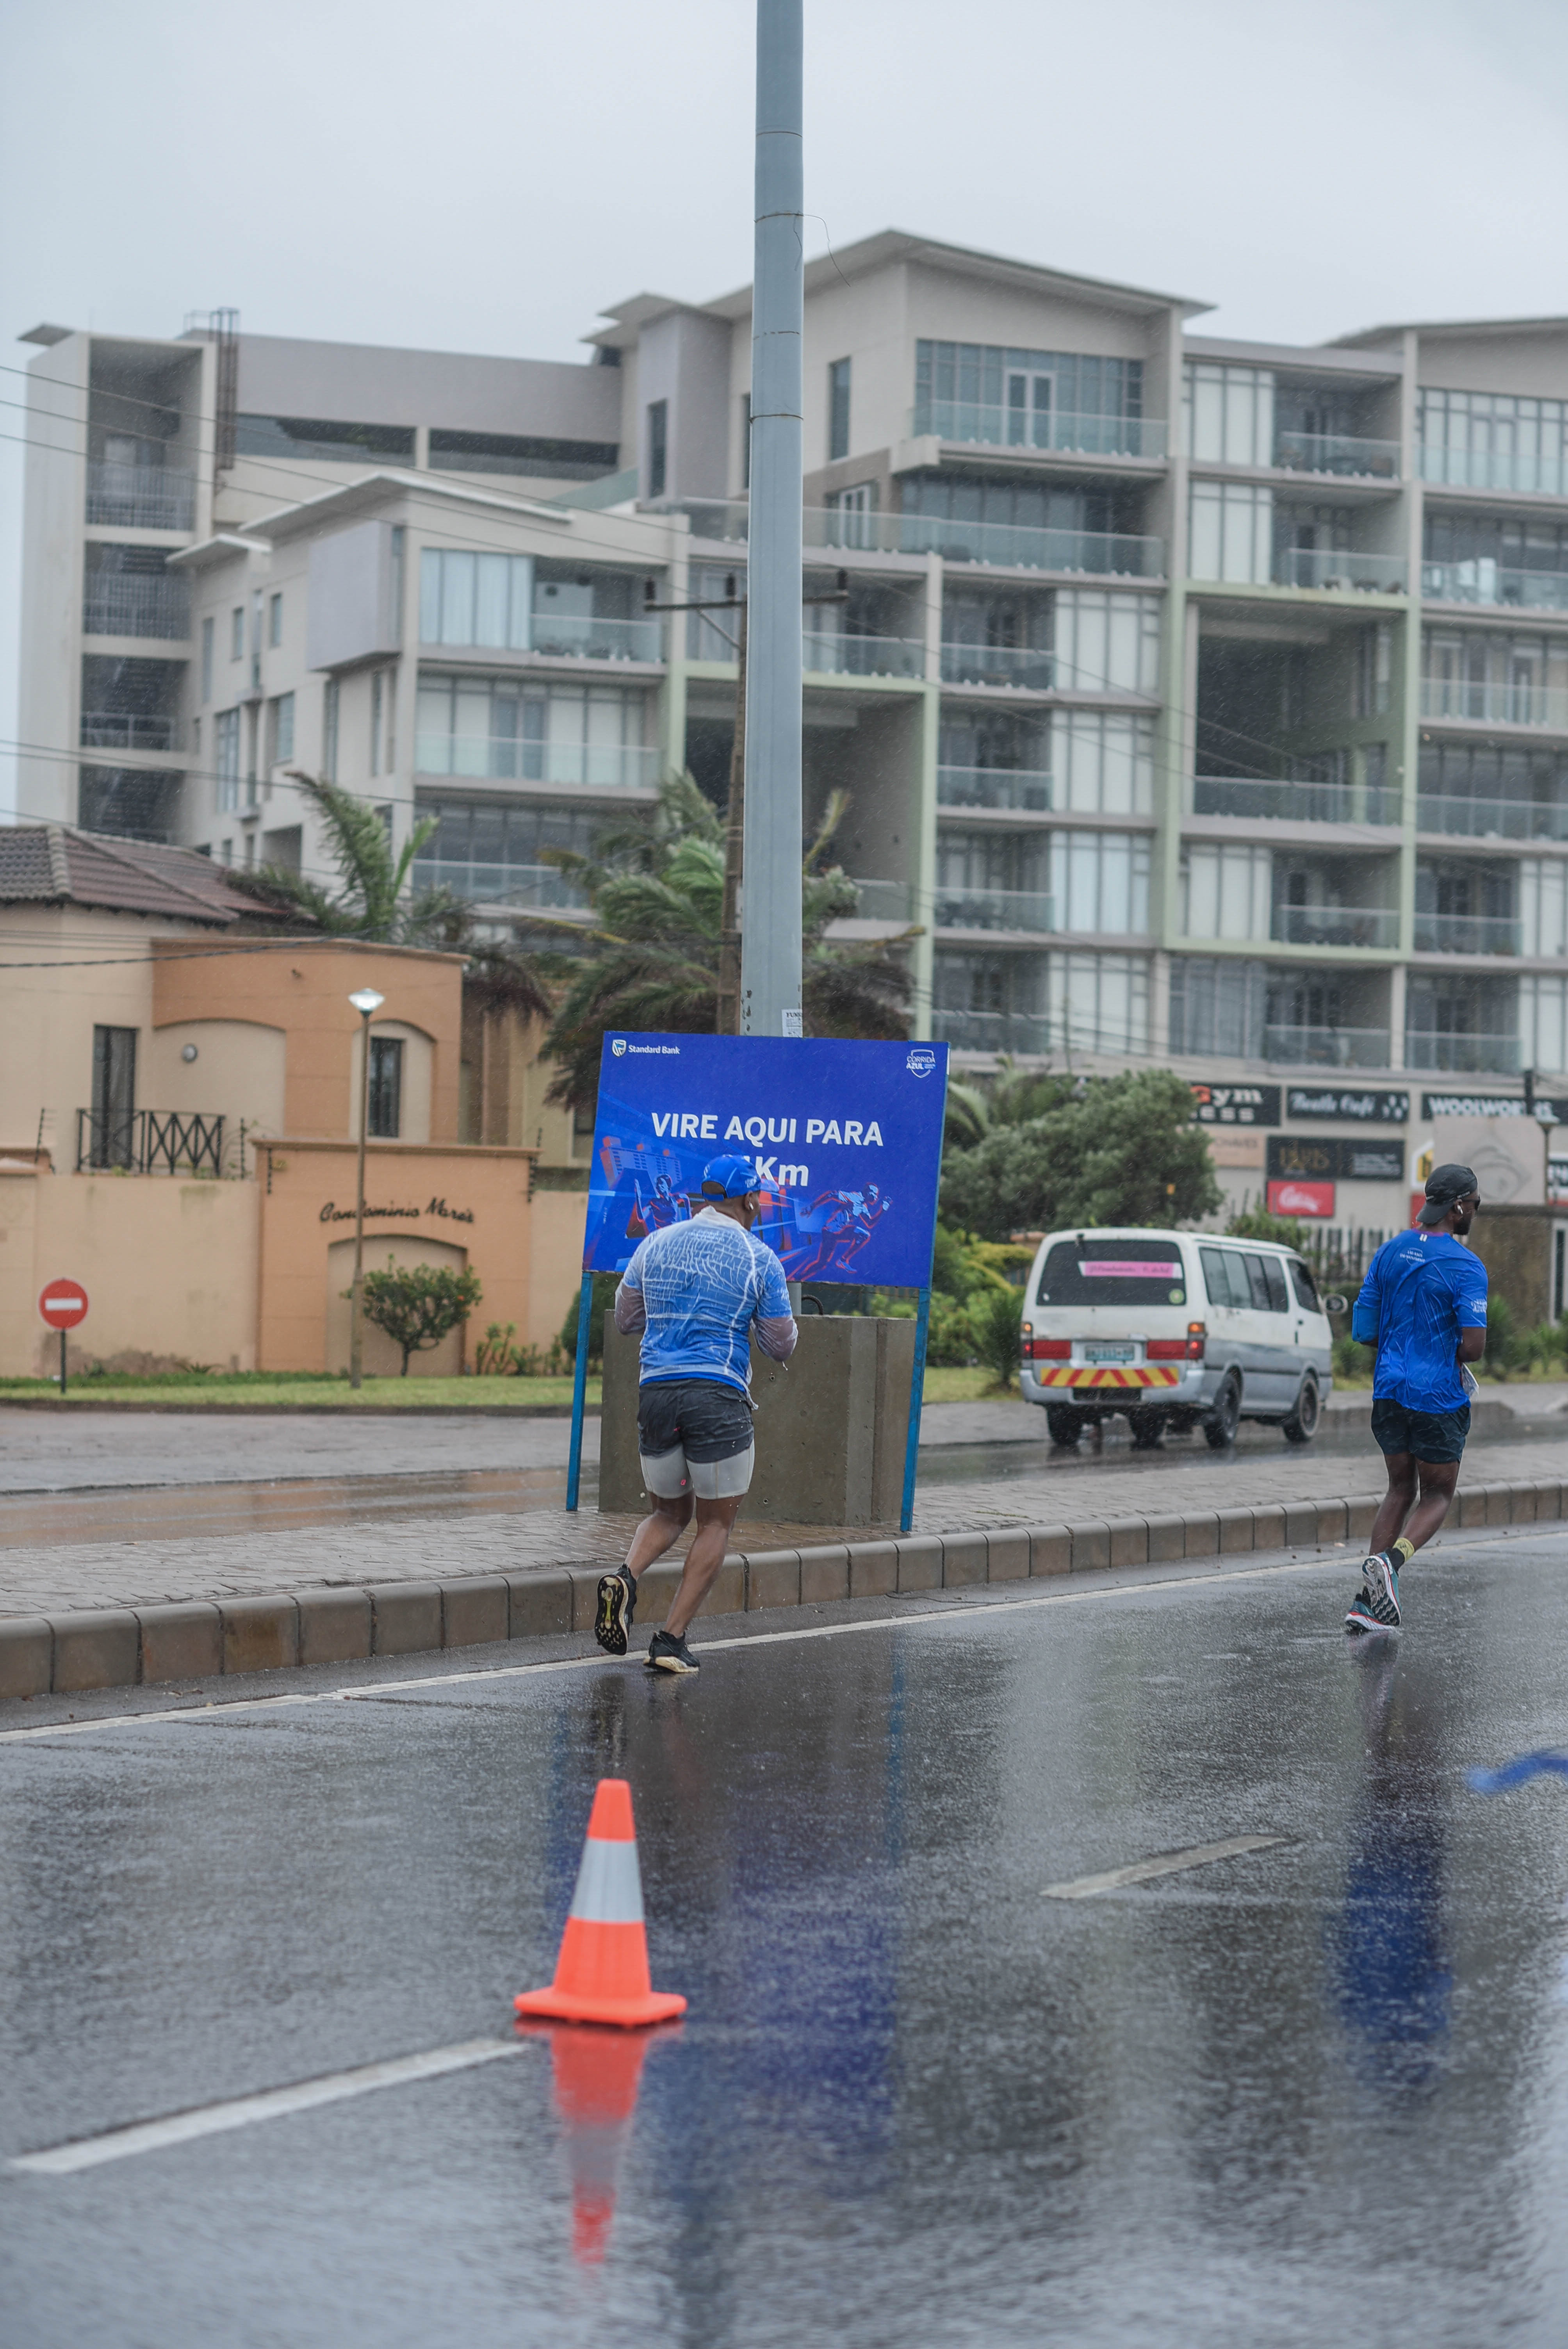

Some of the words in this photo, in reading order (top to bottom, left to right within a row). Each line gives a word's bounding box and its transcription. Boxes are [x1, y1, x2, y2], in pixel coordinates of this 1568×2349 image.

[628, 1044, 661, 1054] Standard
[662, 1046, 680, 1054] Bank
[906, 1062, 925, 1070] AZUL
[907, 1055, 936, 1064] CORRIDA
[1428, 1096, 1553, 1117] WOOLWORHS
[651, 1112, 718, 1139] VIRE
[723, 1115, 796, 1148] AQUI
[806, 1118, 884, 1146] PARA
[743, 1155, 809, 1187] Km
